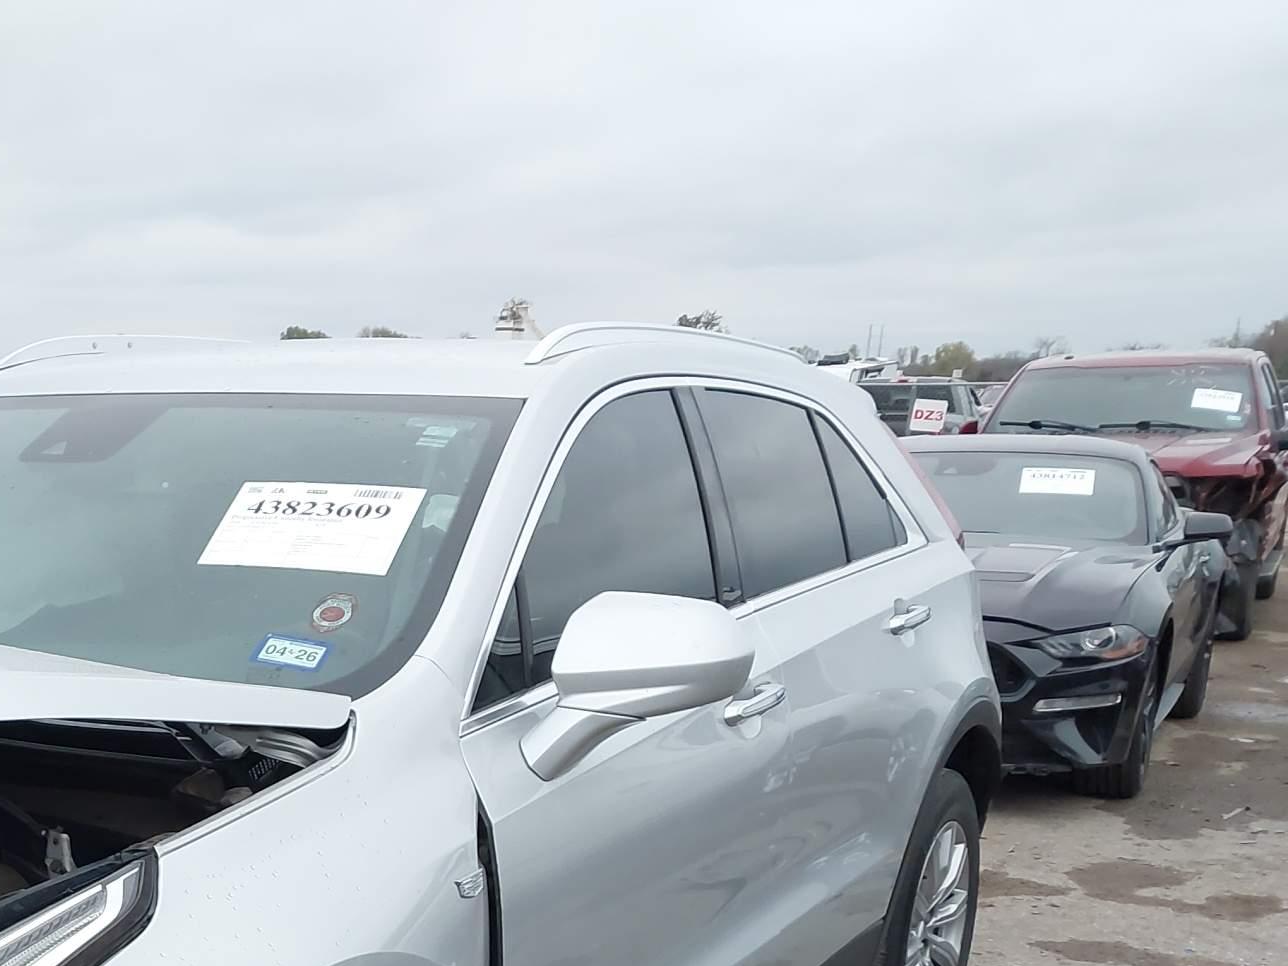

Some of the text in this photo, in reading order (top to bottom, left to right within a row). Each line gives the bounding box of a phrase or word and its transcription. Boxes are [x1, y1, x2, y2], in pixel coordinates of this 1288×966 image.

[914, 409, 944, 421] DZ3
[247, 499, 392, 520] 43823609
[265, 644, 319, 662] 04 26
